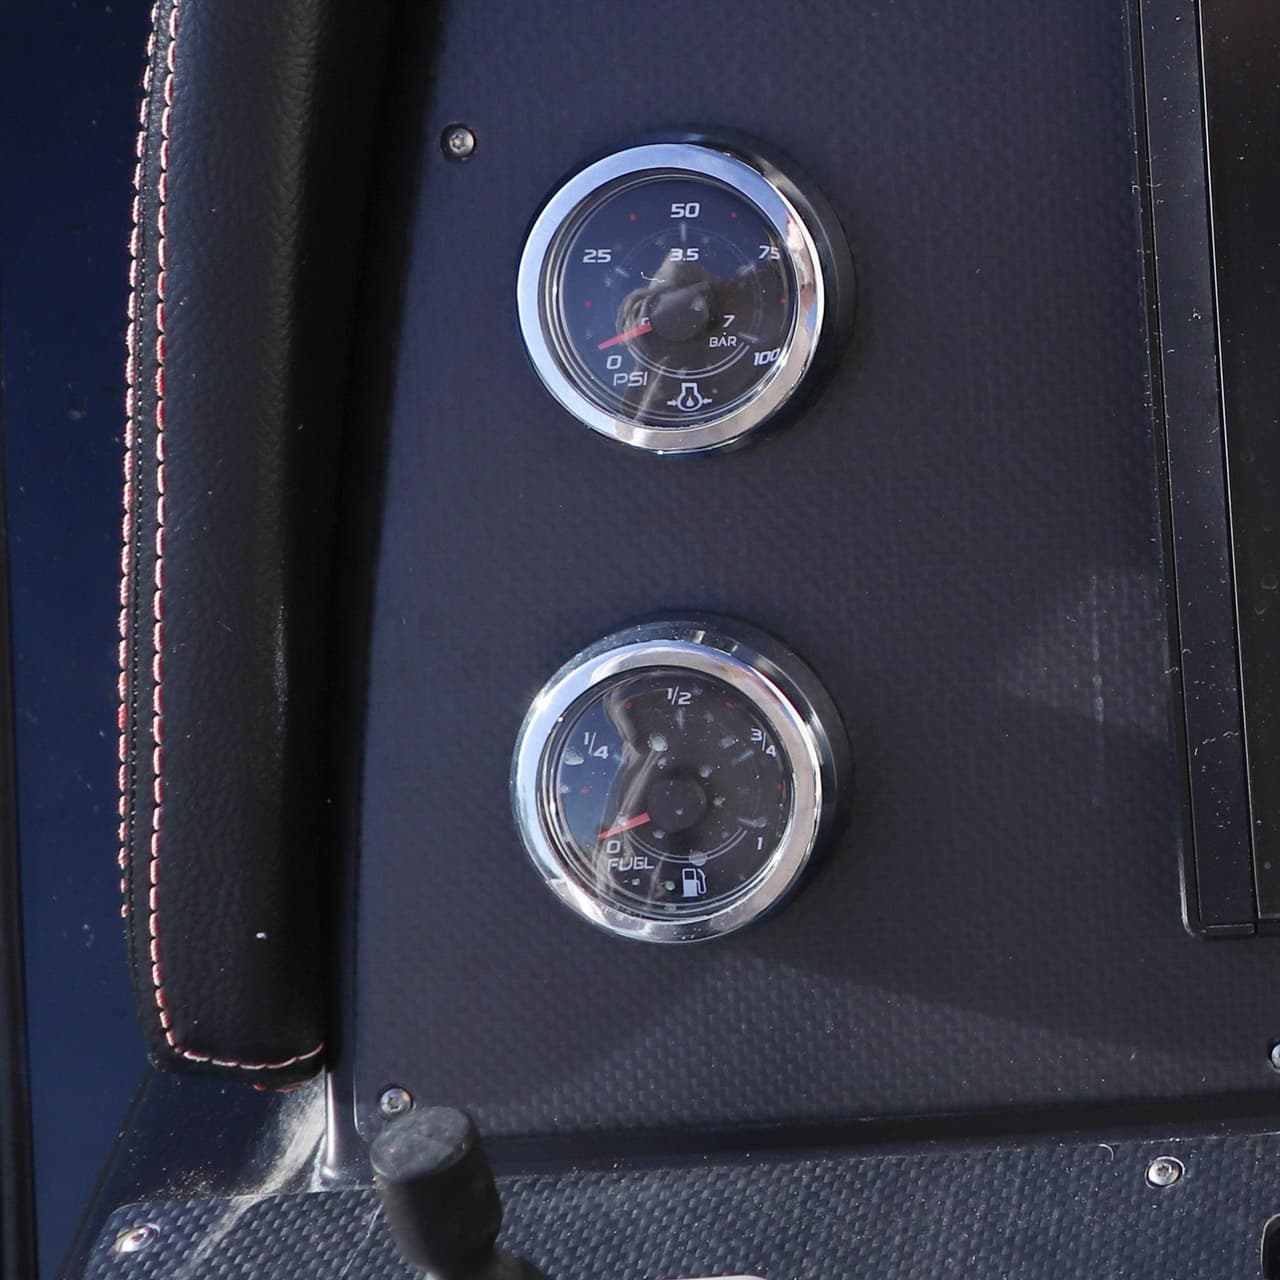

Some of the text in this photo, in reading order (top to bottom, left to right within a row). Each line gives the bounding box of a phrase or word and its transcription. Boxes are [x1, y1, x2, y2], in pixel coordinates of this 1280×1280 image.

[670, 202, 700, 218] 50
[583, 249, 611, 263] 25
[669, 248, 699, 262] 3.5
[758, 245, 781, 260] 75
[723, 315, 735, 327] 7
[709, 336, 737, 348] BAR
[606, 355, 622, 369] 0
[753, 348, 781, 366] 100
[613, 372, 648, 387] PSI
[667, 685, 691, 705] 1/2
[583, 732, 609, 759] 1/4
[750, 728, 776, 757] 3/4
[606, 840, 621, 854] 0
[757, 837, 763, 851] 1
[607, 856, 655, 872] FUEL
